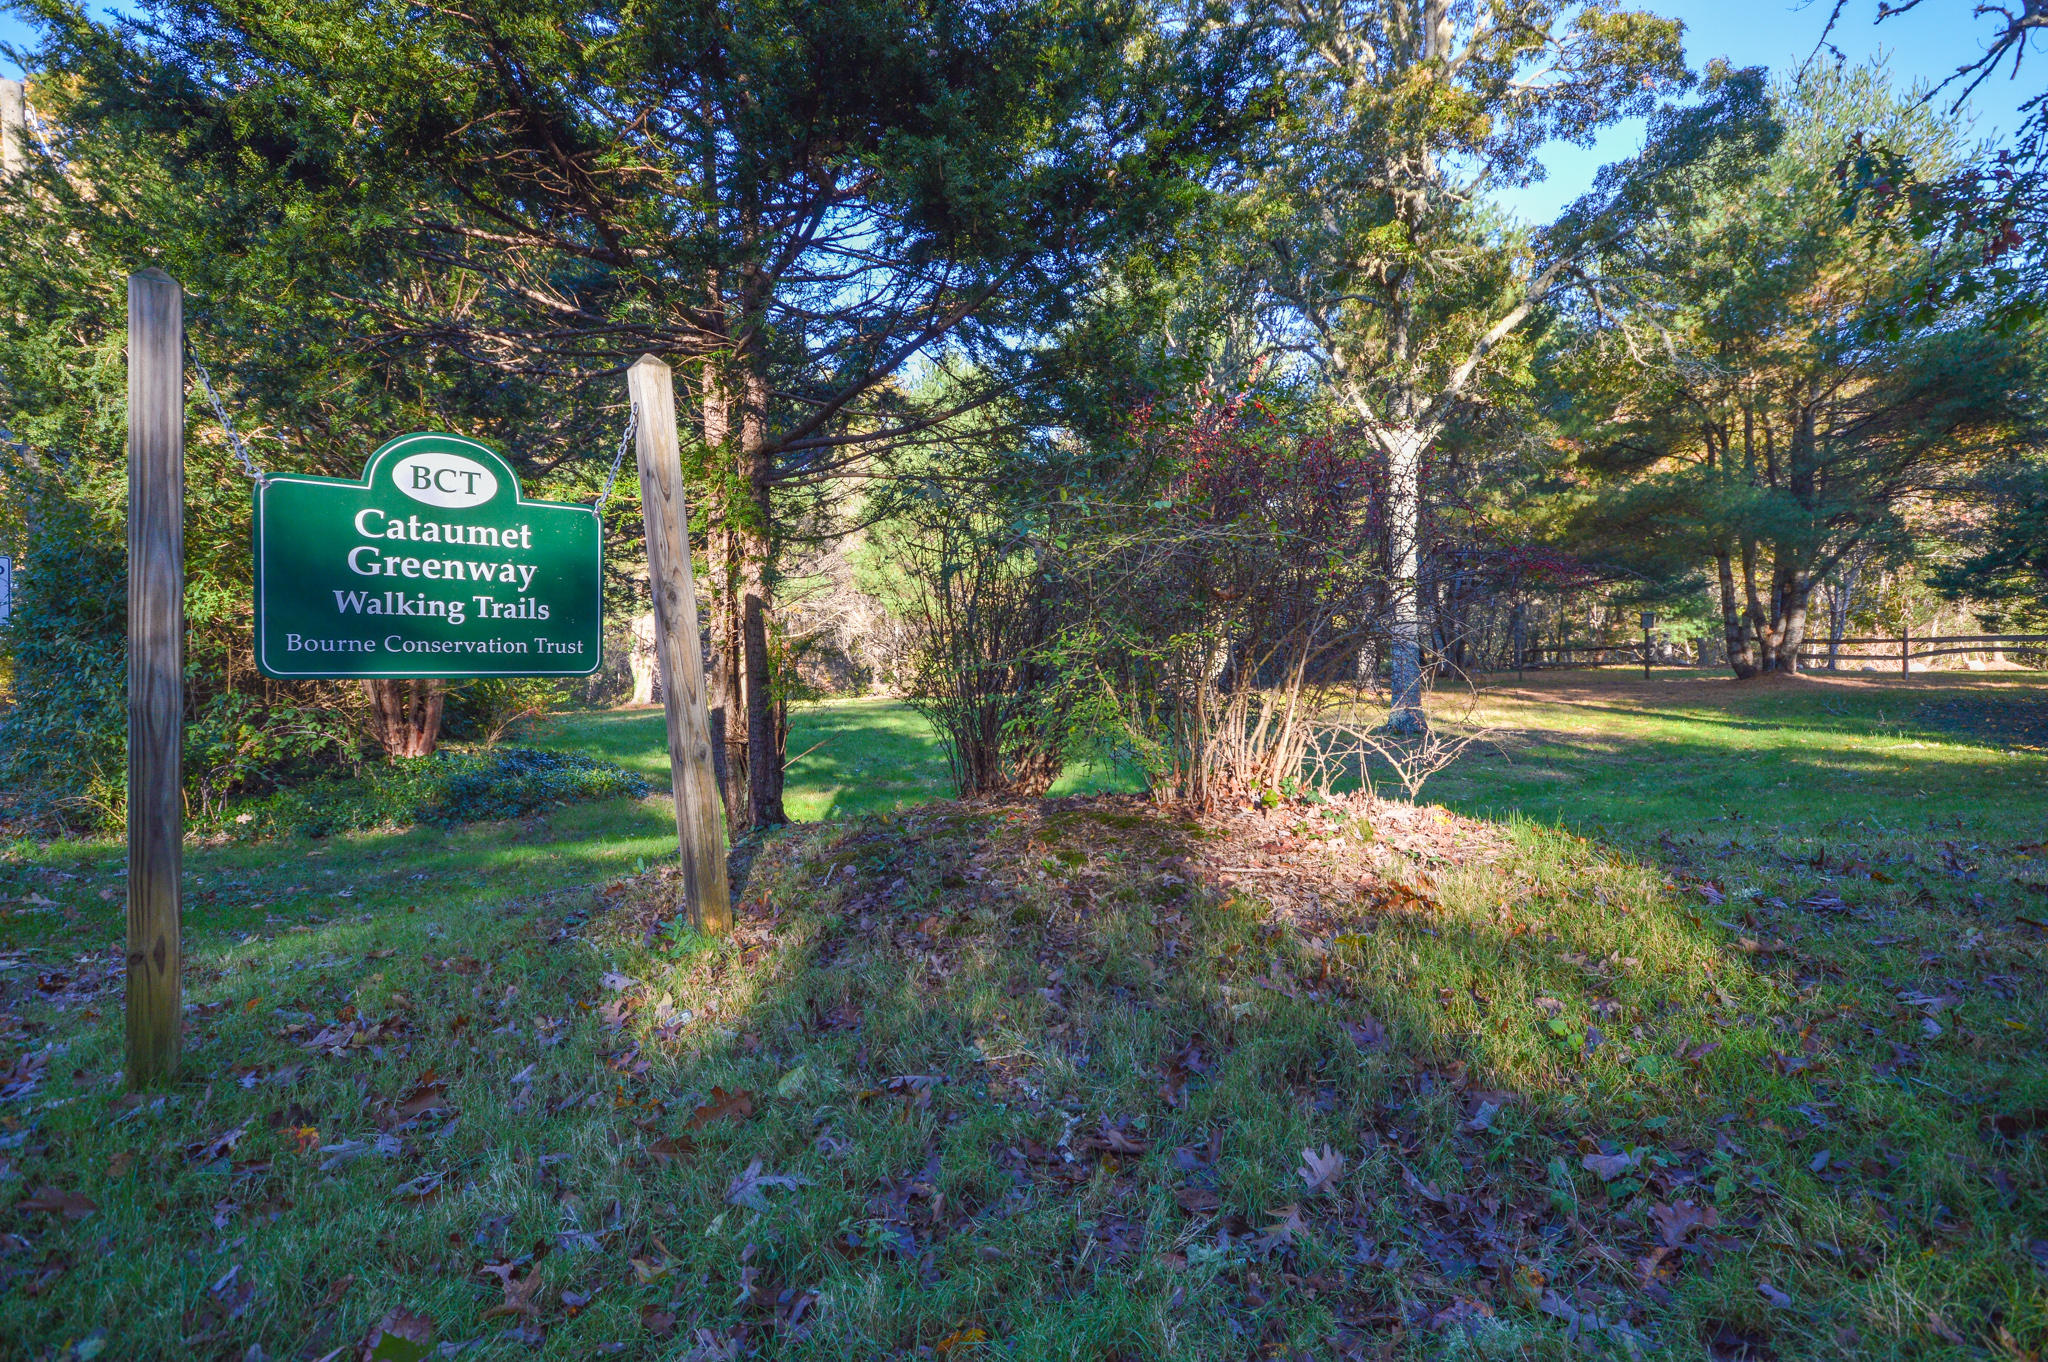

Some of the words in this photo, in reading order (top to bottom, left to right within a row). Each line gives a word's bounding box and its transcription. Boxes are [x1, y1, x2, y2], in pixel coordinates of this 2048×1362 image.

[410, 465, 481, 495] BCT
[354, 508, 532, 549] Cataumet
[348, 546, 537, 592] Greenway
[333, 590, 465, 625] Walking
[473, 595, 550, 620] Trails
[285, 633, 376, 652] Bourne
[384, 635, 528, 654] Conservation
[534, 637, 584, 654] Trust
